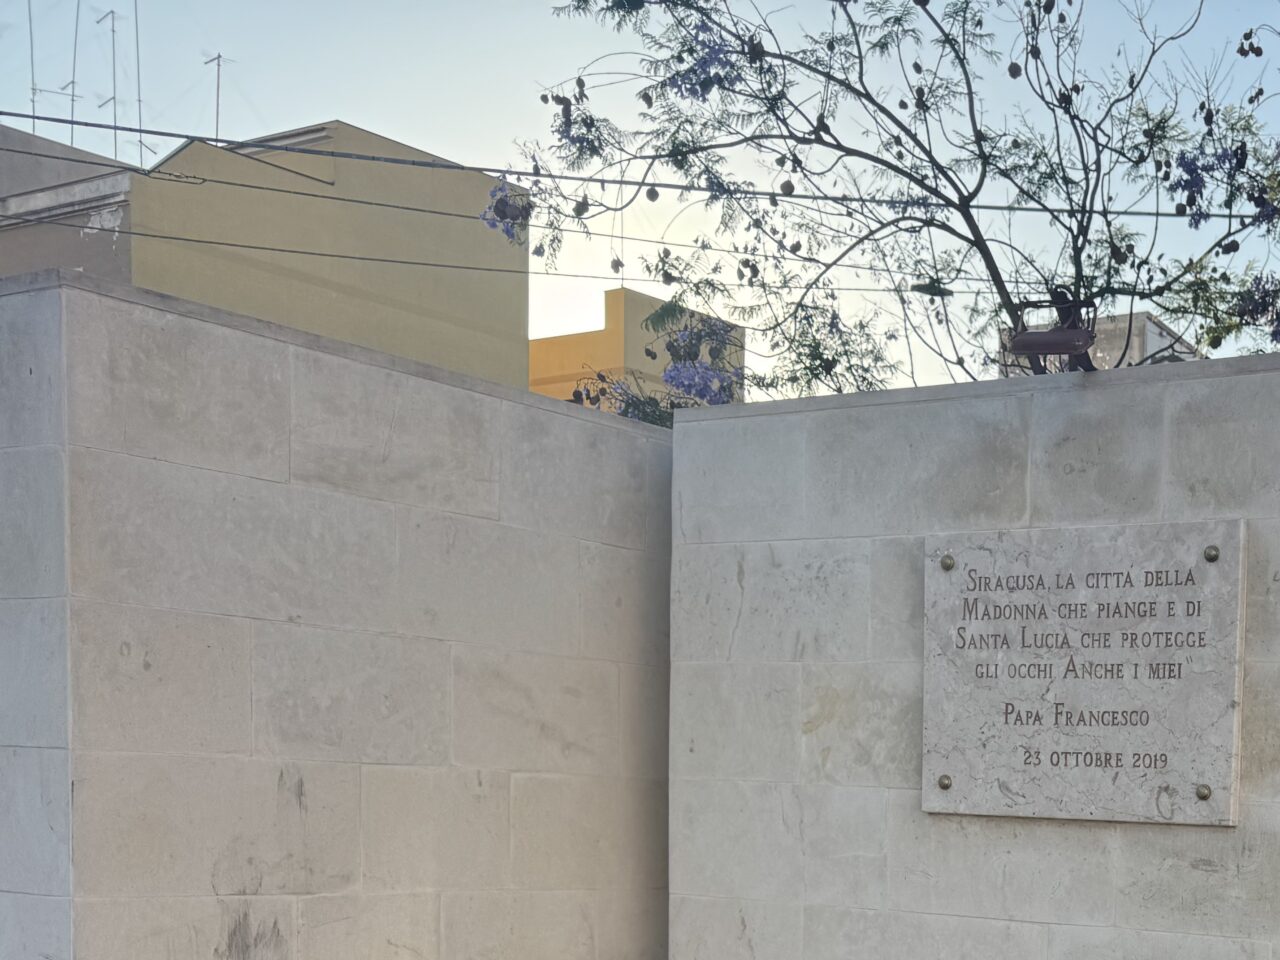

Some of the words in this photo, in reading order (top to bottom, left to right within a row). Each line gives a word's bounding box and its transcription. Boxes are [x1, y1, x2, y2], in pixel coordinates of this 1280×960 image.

[1055, 573, 1076, 589] LA
[1143, 569, 1196, 587] DELLA
[962, 598, 1048, 620] MADONNA
[1057, 602, 1088, 619] CHE
[1097, 601, 1157, 619] PIANGE
[1167, 601, 1176, 617] E
[1185, 600, 1202, 617] DI
[955, 626, 1010, 650] SANTA
[1021, 626, 1071, 649] LUCIA
[1080, 632, 1111, 649] CHE
[1120, 631, 1206, 648] PROTEGGE
[975, 663, 998, 679] GLI
[1008, 662, 1053, 679] OCCHI
[1063, 654, 1124, 680] ANCHE
[1133, 663, 1139, 679] I
[1002, 702, 1043, 726] PAPA
[1053, 702, 1149, 727] FRANCESCO
[1023, 750, 1042, 766] 23
[1050, 751, 1123, 768] OTTOBRE
[1132, 753, 1168, 769] 2019
